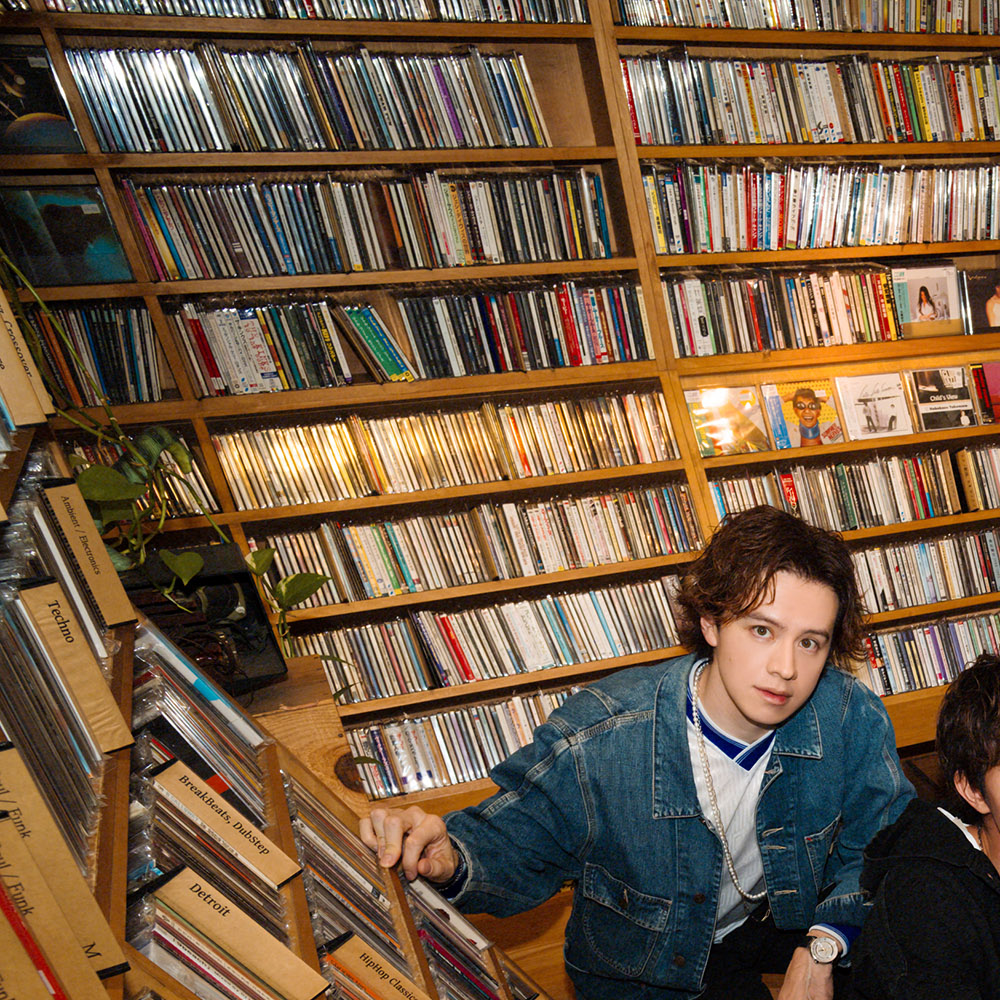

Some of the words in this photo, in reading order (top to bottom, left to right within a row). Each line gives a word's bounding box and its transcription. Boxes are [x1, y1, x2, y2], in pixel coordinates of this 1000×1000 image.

[61, 496, 81, 528] Ambient
[79, 535, 101, 576] Electronics
[48, 600, 75, 643] Techno
[8, 807, 32, 839] Funk
[178, 775, 231, 824] BreakBeats,
[233, 821, 270, 856] DubStep
[8, 881, 35, 916] Funk
[189, 883, 231, 917] Detroit
[82, 942, 102, 959] M
[359, 952, 390, 980] HipHop
